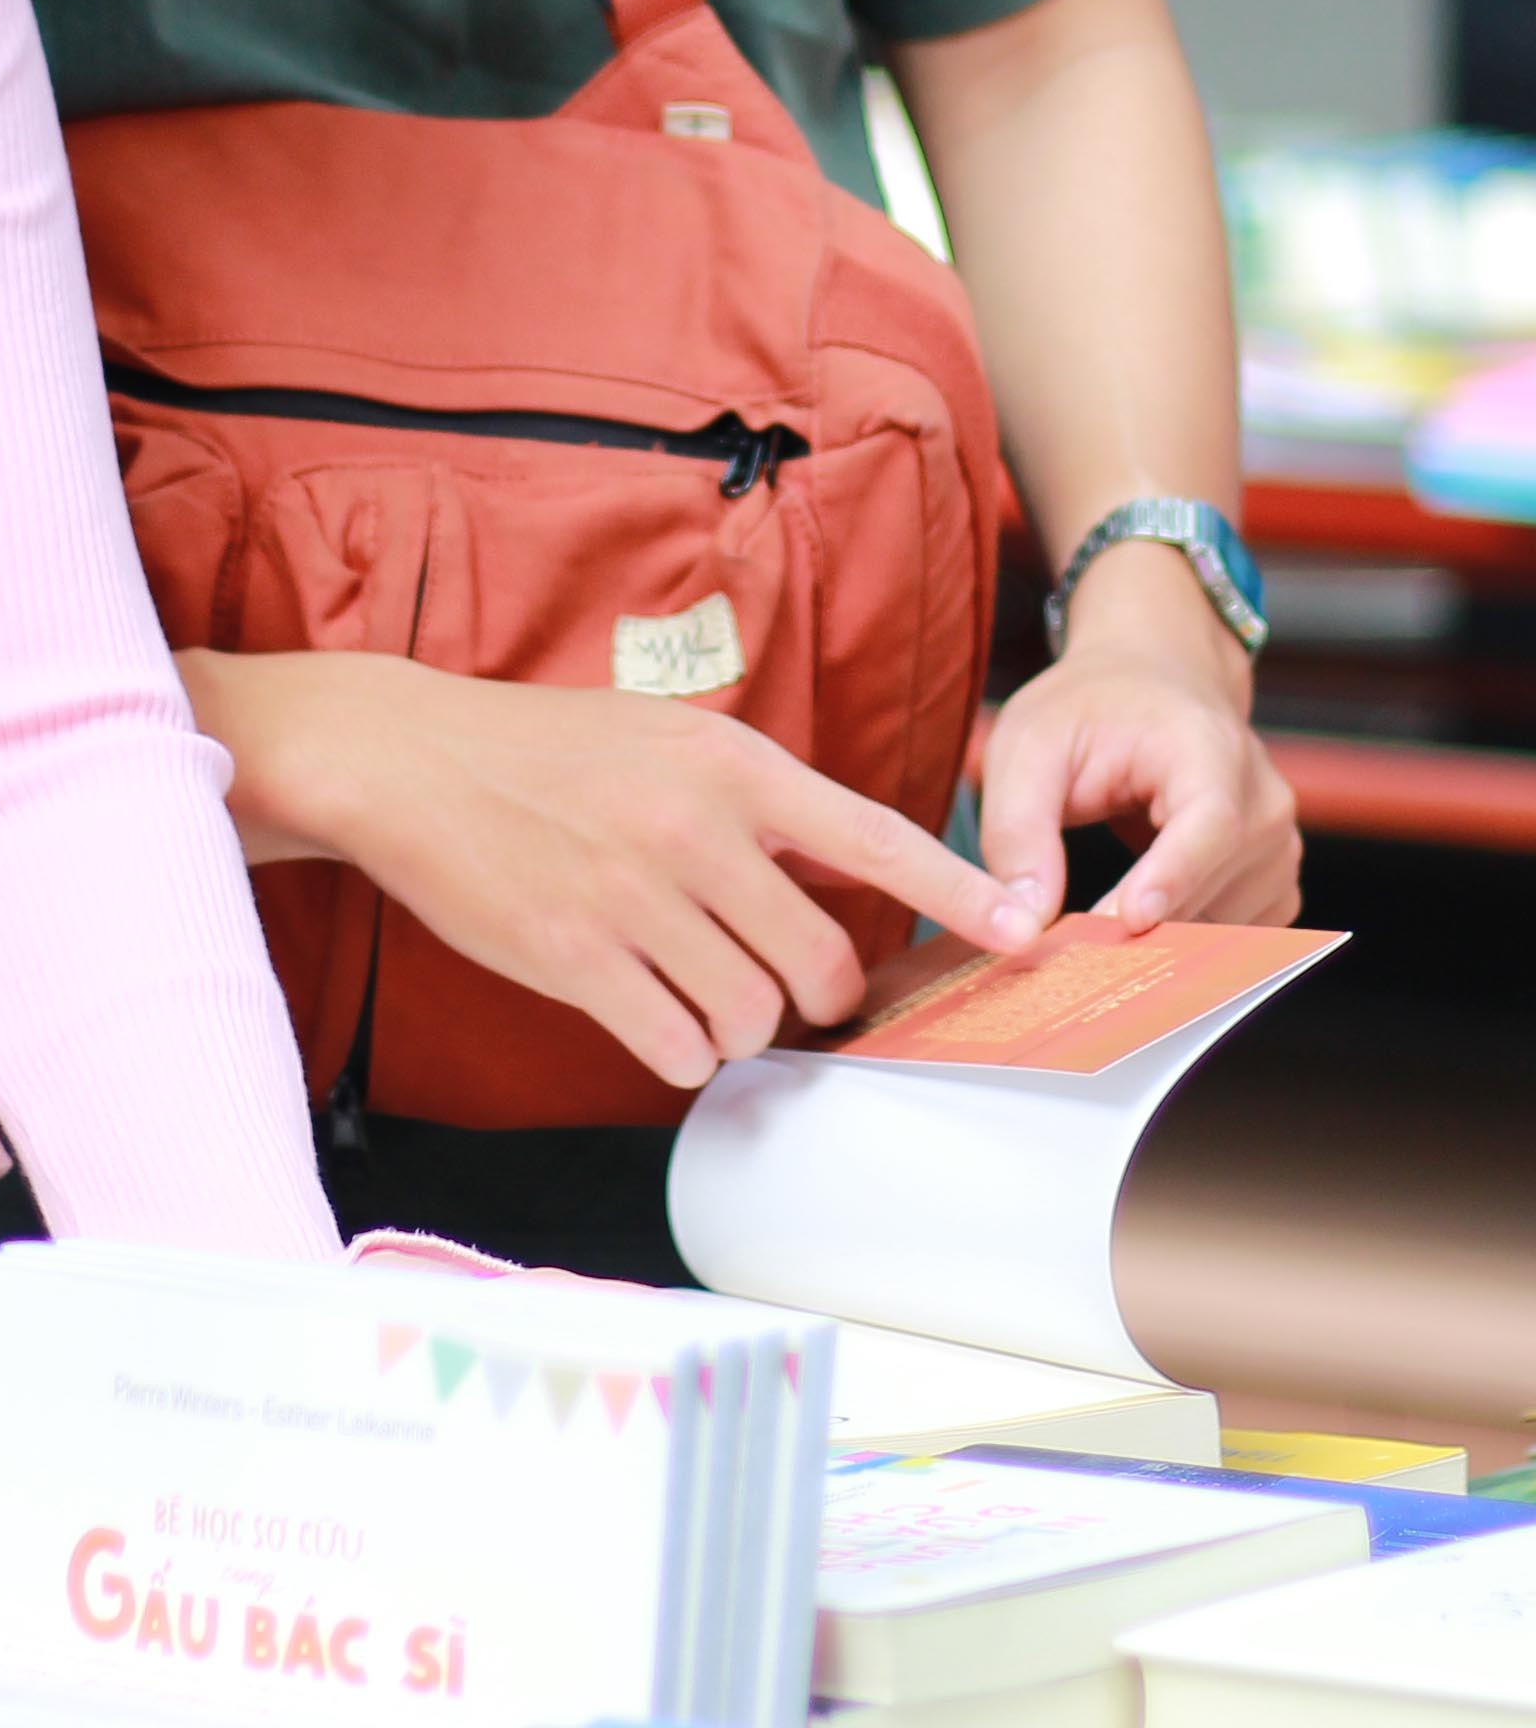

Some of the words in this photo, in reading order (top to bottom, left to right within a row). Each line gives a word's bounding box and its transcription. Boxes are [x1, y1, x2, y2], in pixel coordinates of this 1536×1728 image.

[260, 1393, 331, 1432] Esther
[66, 1526, 220, 1661] GẤU
[243, 1594, 370, 1687] BÁC
